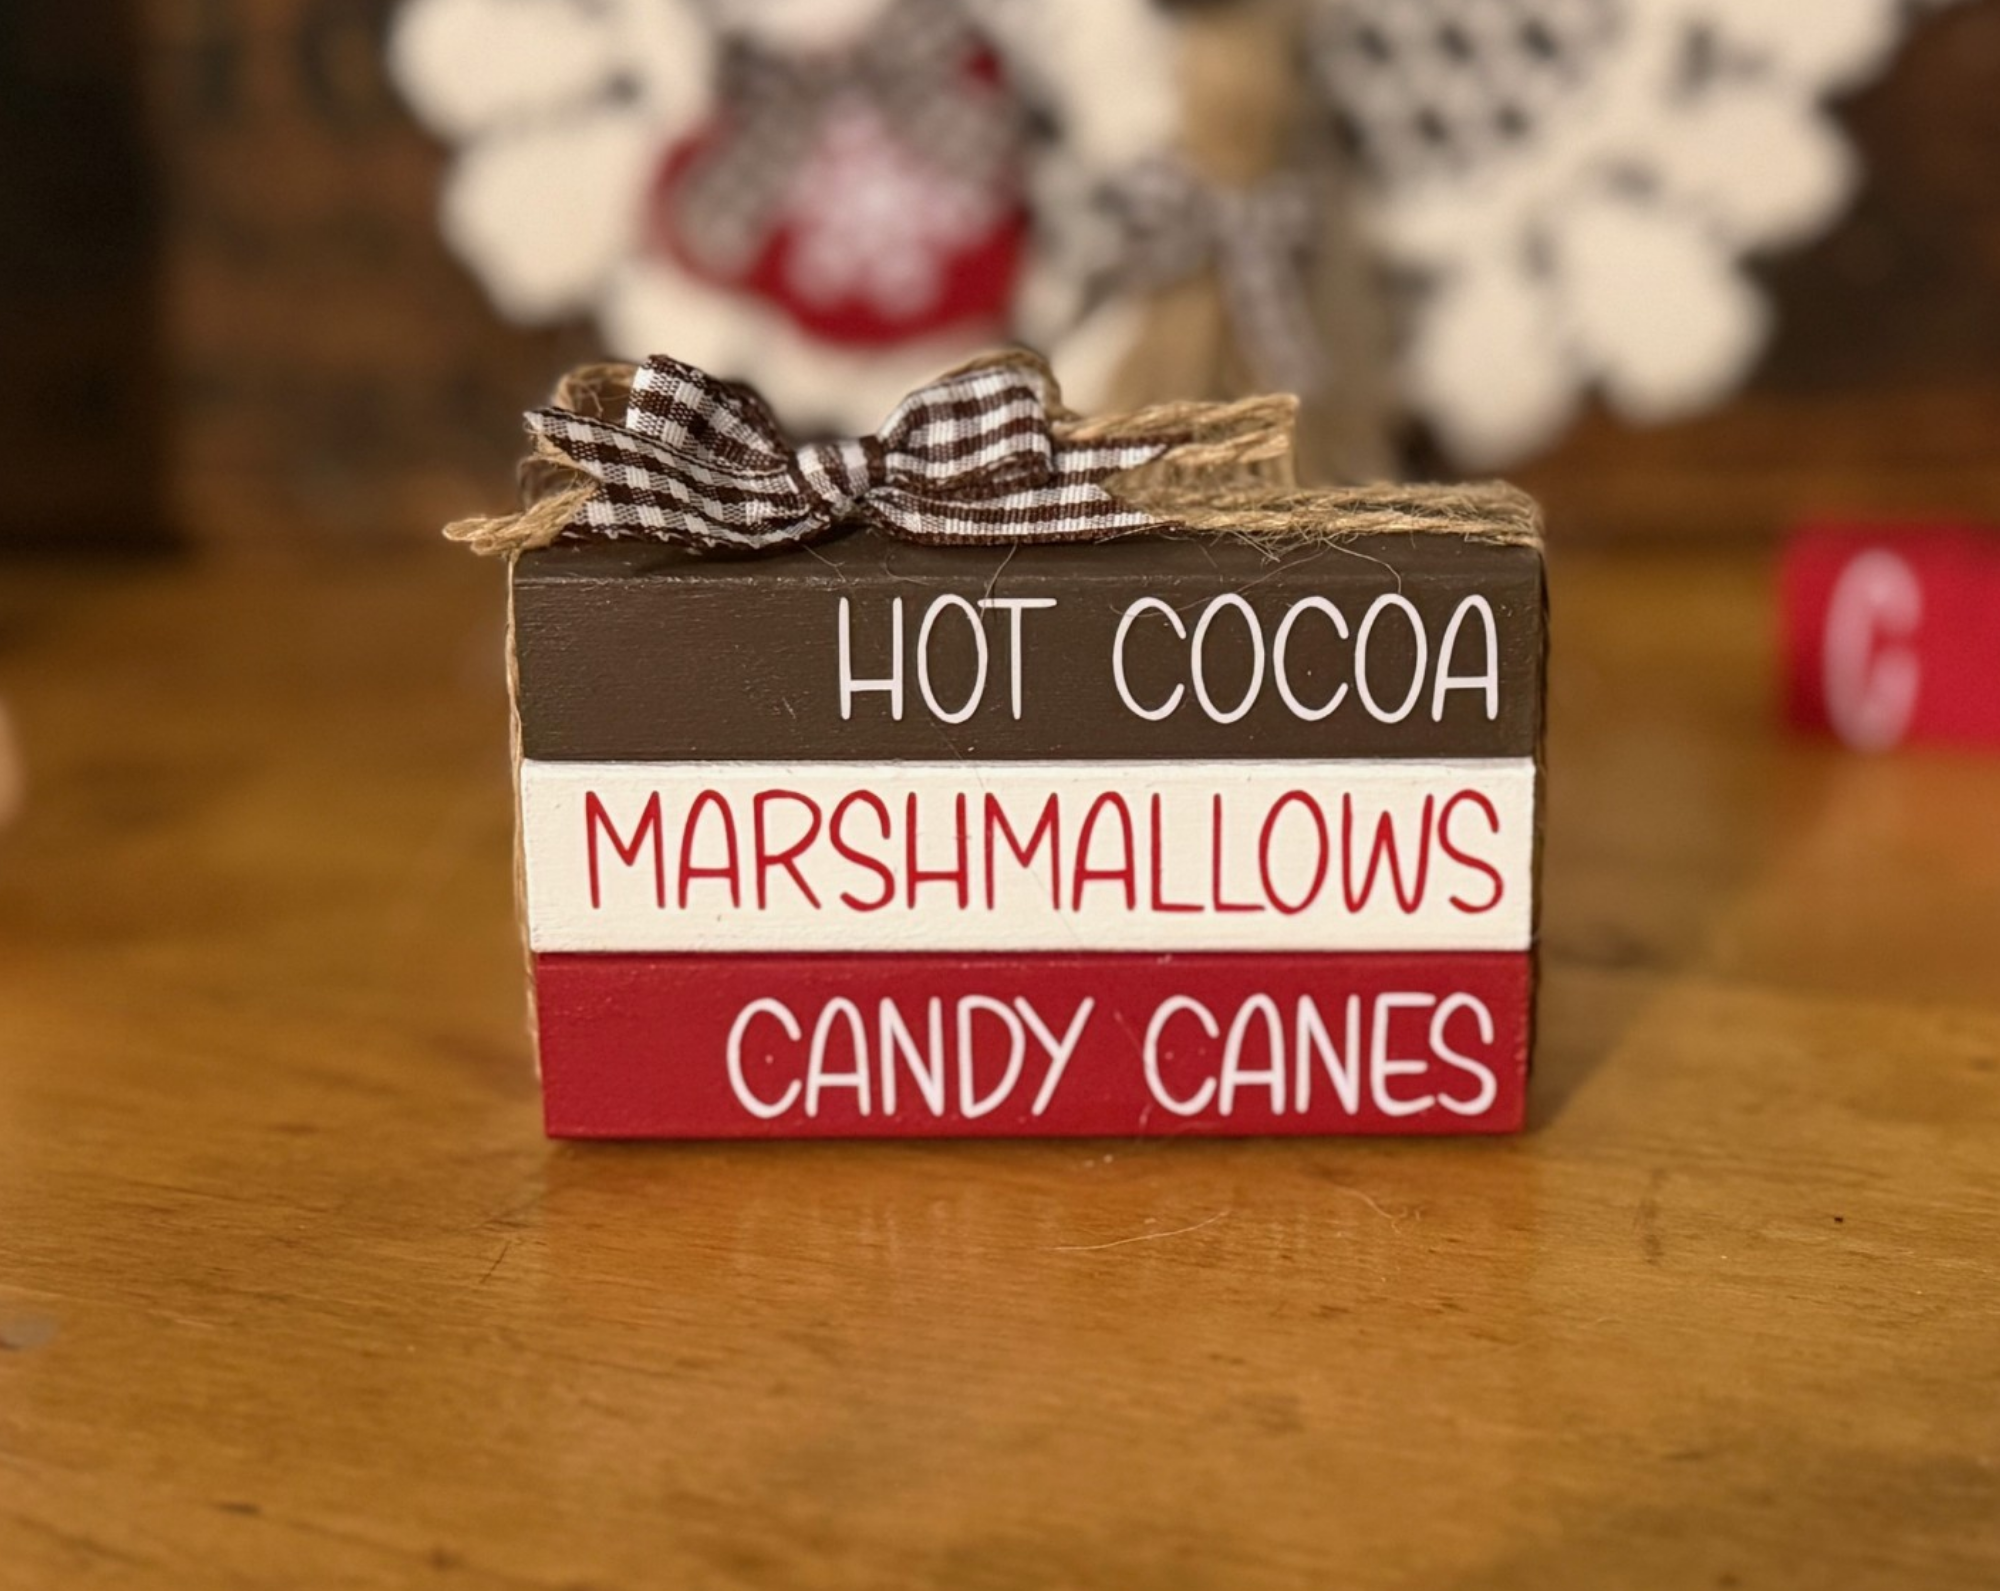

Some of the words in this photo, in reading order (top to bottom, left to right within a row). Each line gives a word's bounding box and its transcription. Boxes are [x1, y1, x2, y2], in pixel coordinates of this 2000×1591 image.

[837, 593, 1057, 724] HOT
[1112, 593, 1499, 724] COCOA
[585, 789, 1504, 916] MARSHMALLOWS
[725, 995, 1094, 1119] CANDY
[1142, 993, 1497, 1117] CANES
